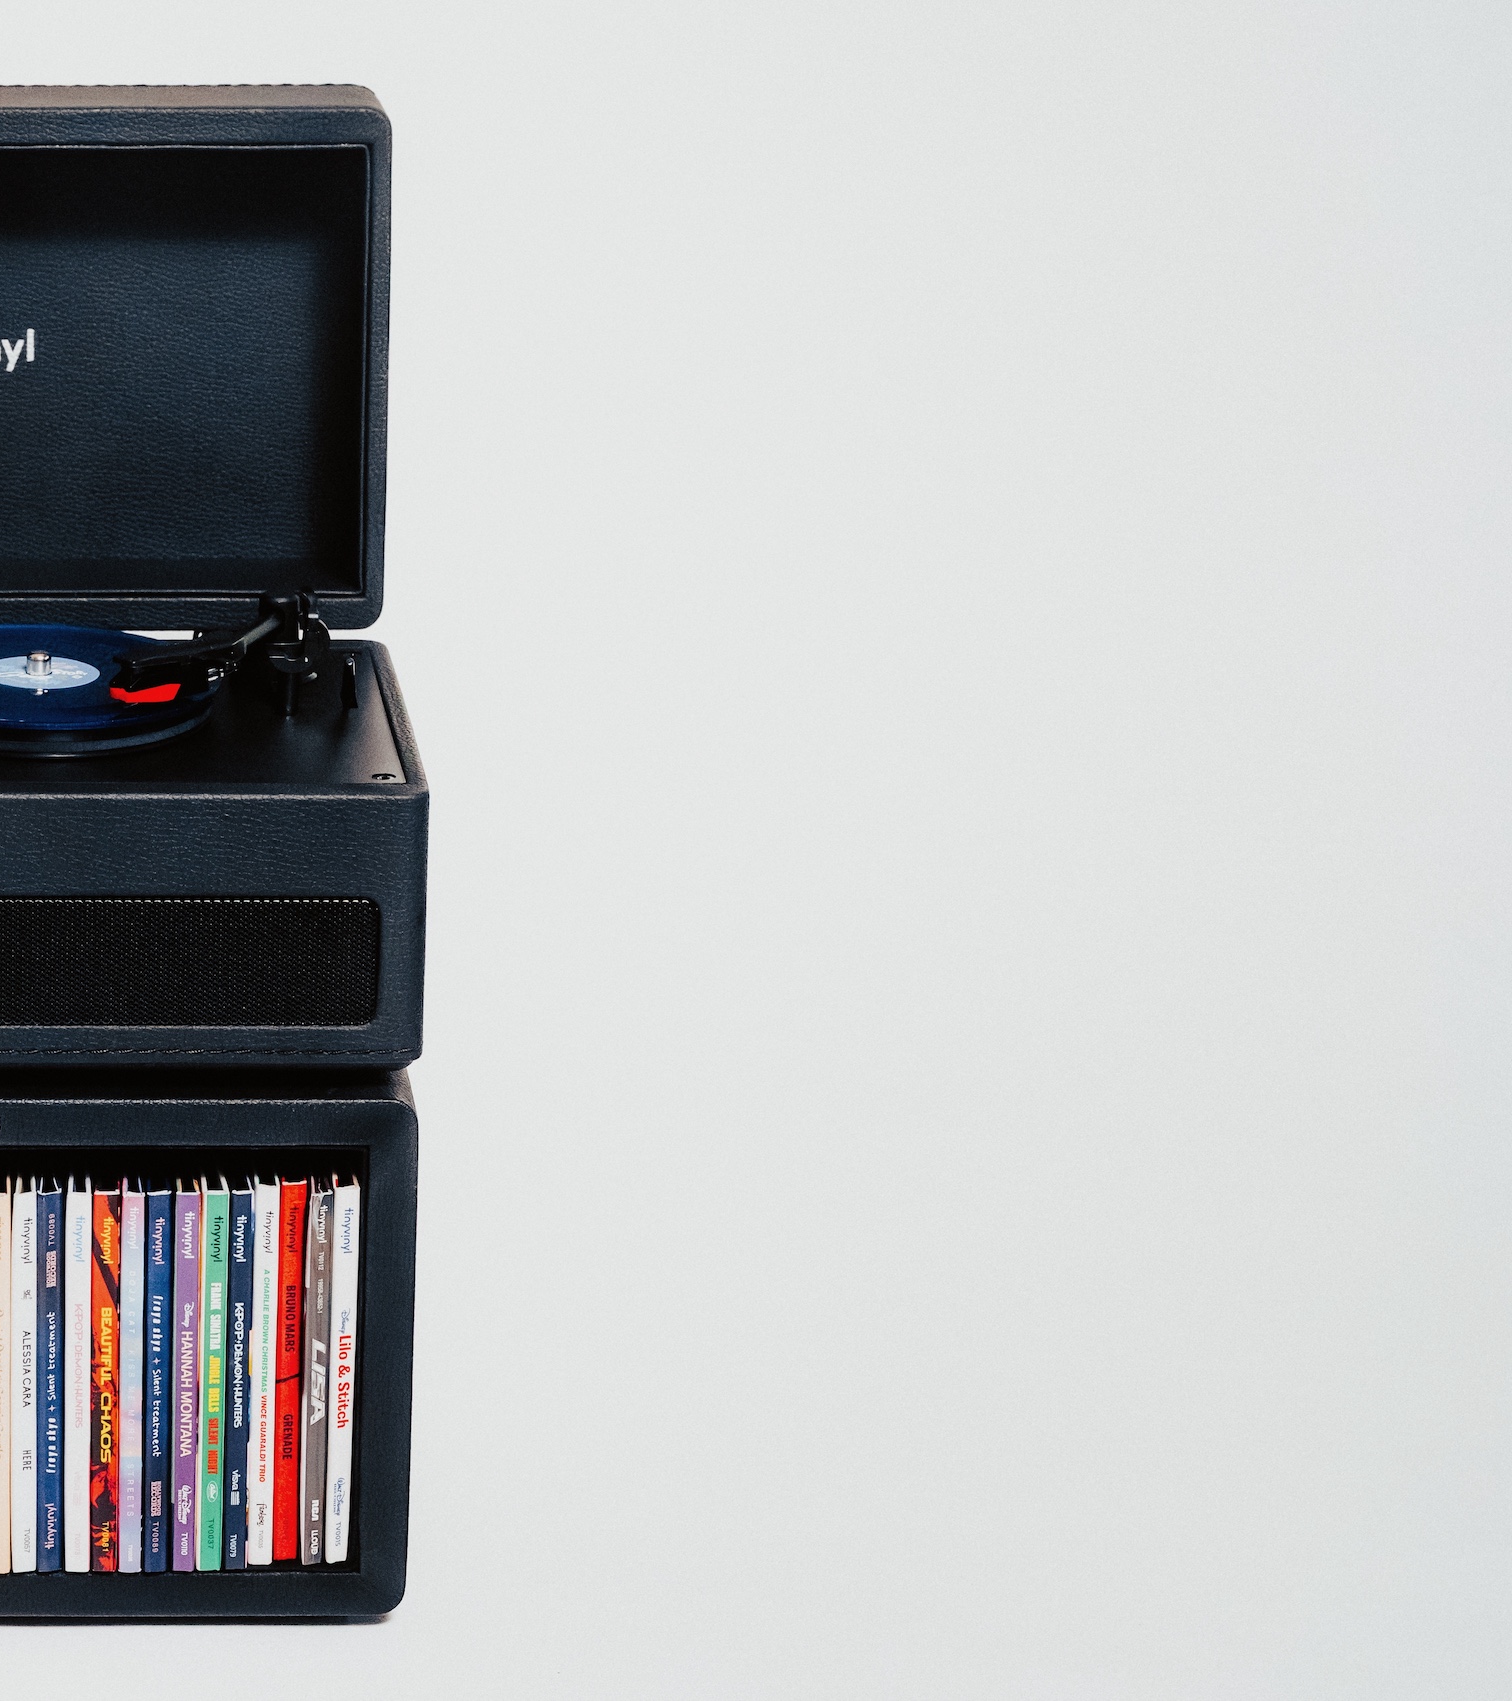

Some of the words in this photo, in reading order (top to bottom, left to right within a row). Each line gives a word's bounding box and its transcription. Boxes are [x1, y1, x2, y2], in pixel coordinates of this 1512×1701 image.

[21, 1218, 33, 1264] tinyvinyl
[73, 1216, 85, 1263] tinyvinyl
[100, 1217, 113, 1264] tinyvinyl
[127, 1207, 139, 1249] tinyvinyl
[152, 1217, 165, 1265] tinyvinyl
[181, 1212, 195, 1259] tinyvinyl
[211, 1216, 223, 1262] tinyvinyl
[233, 1215, 247, 1262] tinyvinyl
[263, 1211, 274, 1253] tinyvinyl
[286, 1206, 298, 1252] tinyvinyl
[317, 1205, 328, 1243] tinyvinyl
[340, 1207, 354, 1254] tinyvinyl
[210, 1283, 221, 1310] FRANK
[286, 1285, 296, 1320] BRUNO
[23, 1330, 31, 1374] ALESSIA
[101, 1308, 112, 1385] BEAUTIFUL
[210, 1314, 221, 1350] SINATRA
[285, 1324, 295, 1352] MARS
[339, 1335, 351, 1360] Lilo
[153, 1370, 161, 1395] Silent
[181, 1332, 193, 1388] HANNAH
[209, 1355, 220, 1384] JINGLE
[311, 1339, 326, 1426] LISA
[338, 1365, 350, 1378] &
[23, 1375, 31, 1408] CARA
[208, 1388, 220, 1412] BELLS
[337, 1383, 350, 1428] Stitch
[100, 1392, 111, 1463] CHAOS
[152, 1400, 161, 1457] treatment
[180, 1392, 192, 1457] MONTANA
[208, 1418, 218, 1445] SILENT
[282, 1414, 293, 1460] GRENADE
[23, 1450, 31, 1471] HERE
[208, 1450, 218, 1474] NIGHT
[44, 1504, 56, 1549] tinyvinyl
